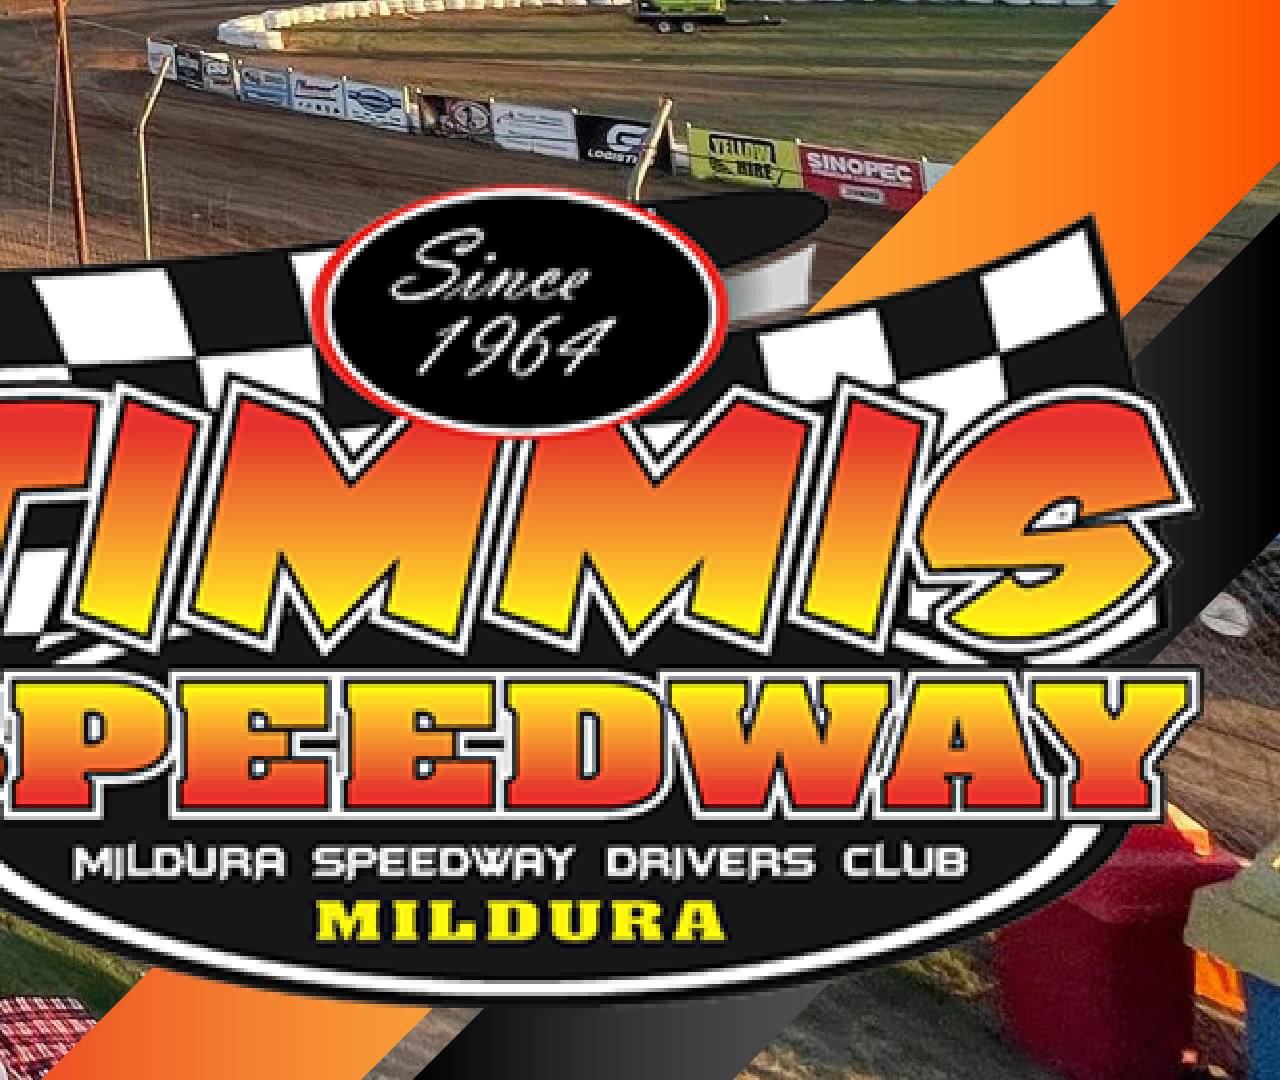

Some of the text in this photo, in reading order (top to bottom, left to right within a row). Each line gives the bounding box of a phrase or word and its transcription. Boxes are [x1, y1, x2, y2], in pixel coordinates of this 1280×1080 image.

[587, 147, 641, 167] LOGISTI
[711, 136, 773, 163] YELLOW
[737, 160, 773, 180] HIRE
[807, 151, 913, 183] SINOPEC
